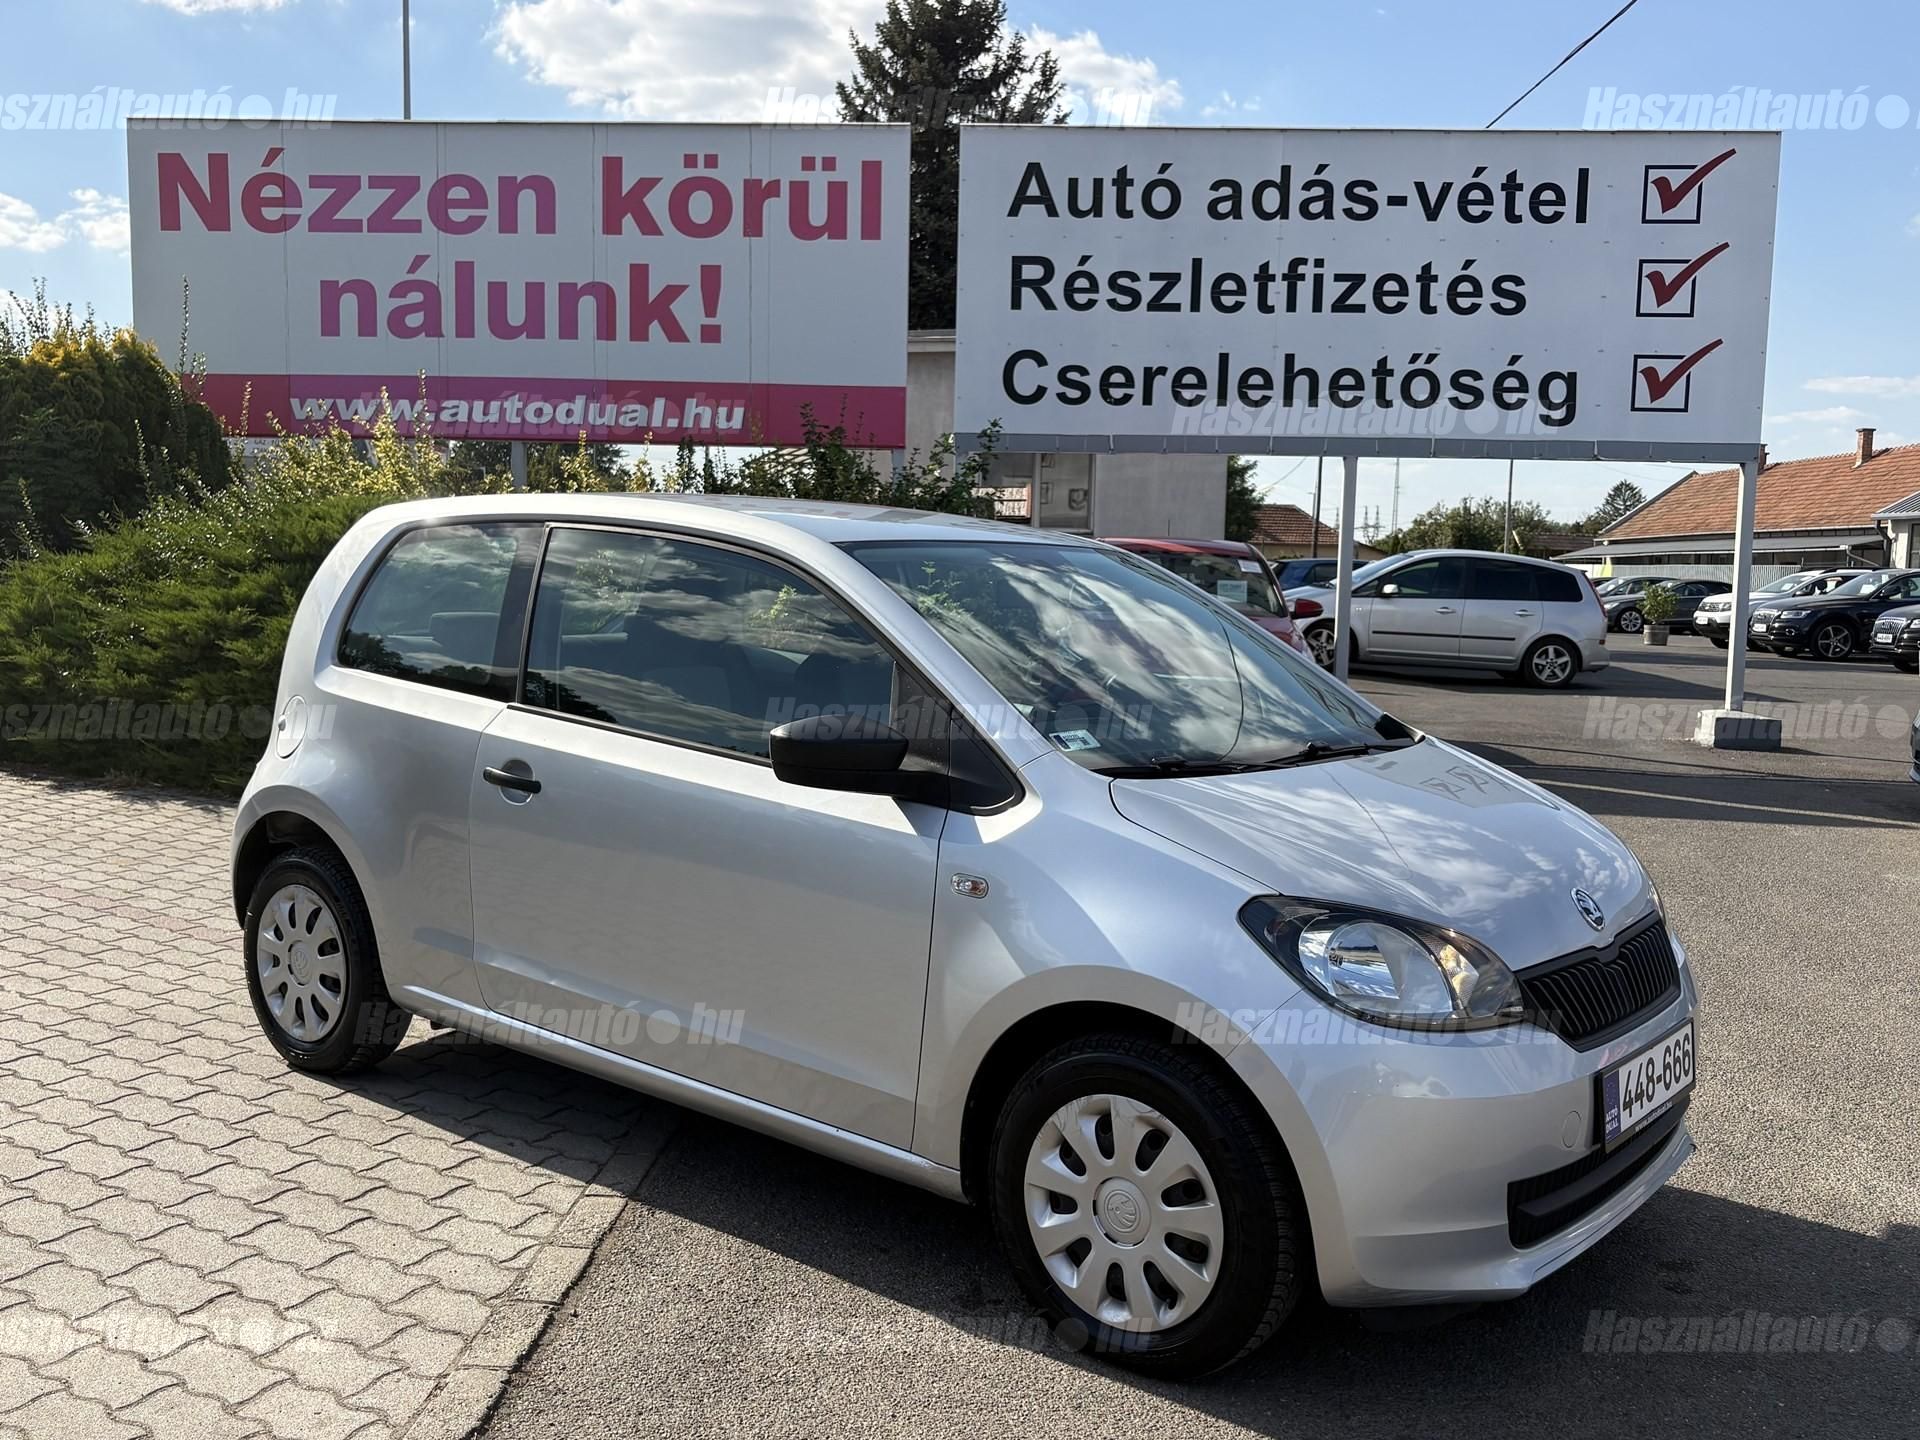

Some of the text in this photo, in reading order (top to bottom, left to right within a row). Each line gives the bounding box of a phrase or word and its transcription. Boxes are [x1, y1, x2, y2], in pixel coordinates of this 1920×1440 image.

[156, 147, 883, 242] Nézzen körül
[1006, 161, 1590, 225] Autó adás-vétel
[319, 254, 723, 345] nálunk!
[1009, 256, 1527, 317] Részletfizetés
[289, 393, 745, 430] www.autodual.hu
[1001, 349, 1579, 427] Cserelehetőség
[1622, 1033, 1691, 1118] 448-666
